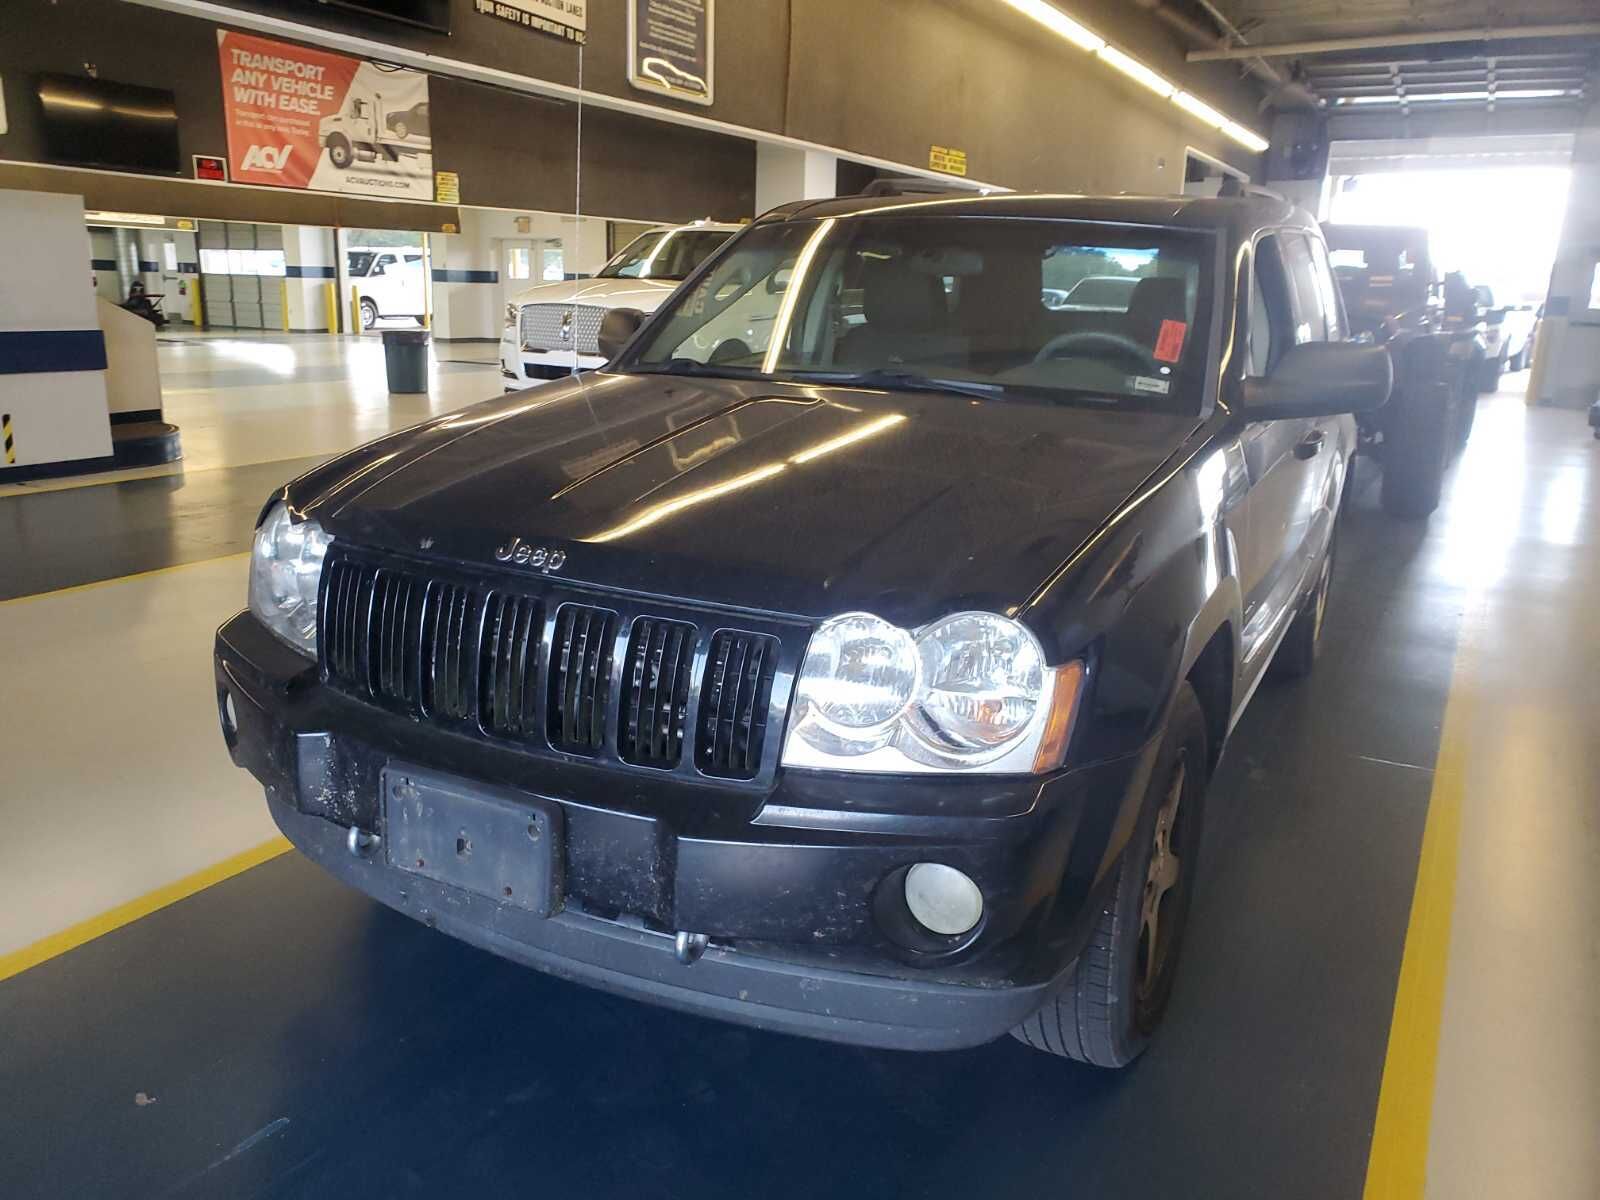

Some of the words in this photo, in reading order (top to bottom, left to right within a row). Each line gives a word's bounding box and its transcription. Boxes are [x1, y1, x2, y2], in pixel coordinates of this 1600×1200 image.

[495, 4, 521, 23] SAFETY
[522, 12, 530, 26] IS
[231, 48, 325, 80] TRANSPORT
[232, 67, 267, 88] ANY
[271, 76, 335, 100] VEHICLE
[233, 86, 276, 108] WITH
[240, 144, 294, 170] ACV
[495, 537, 567, 574] Jeep
